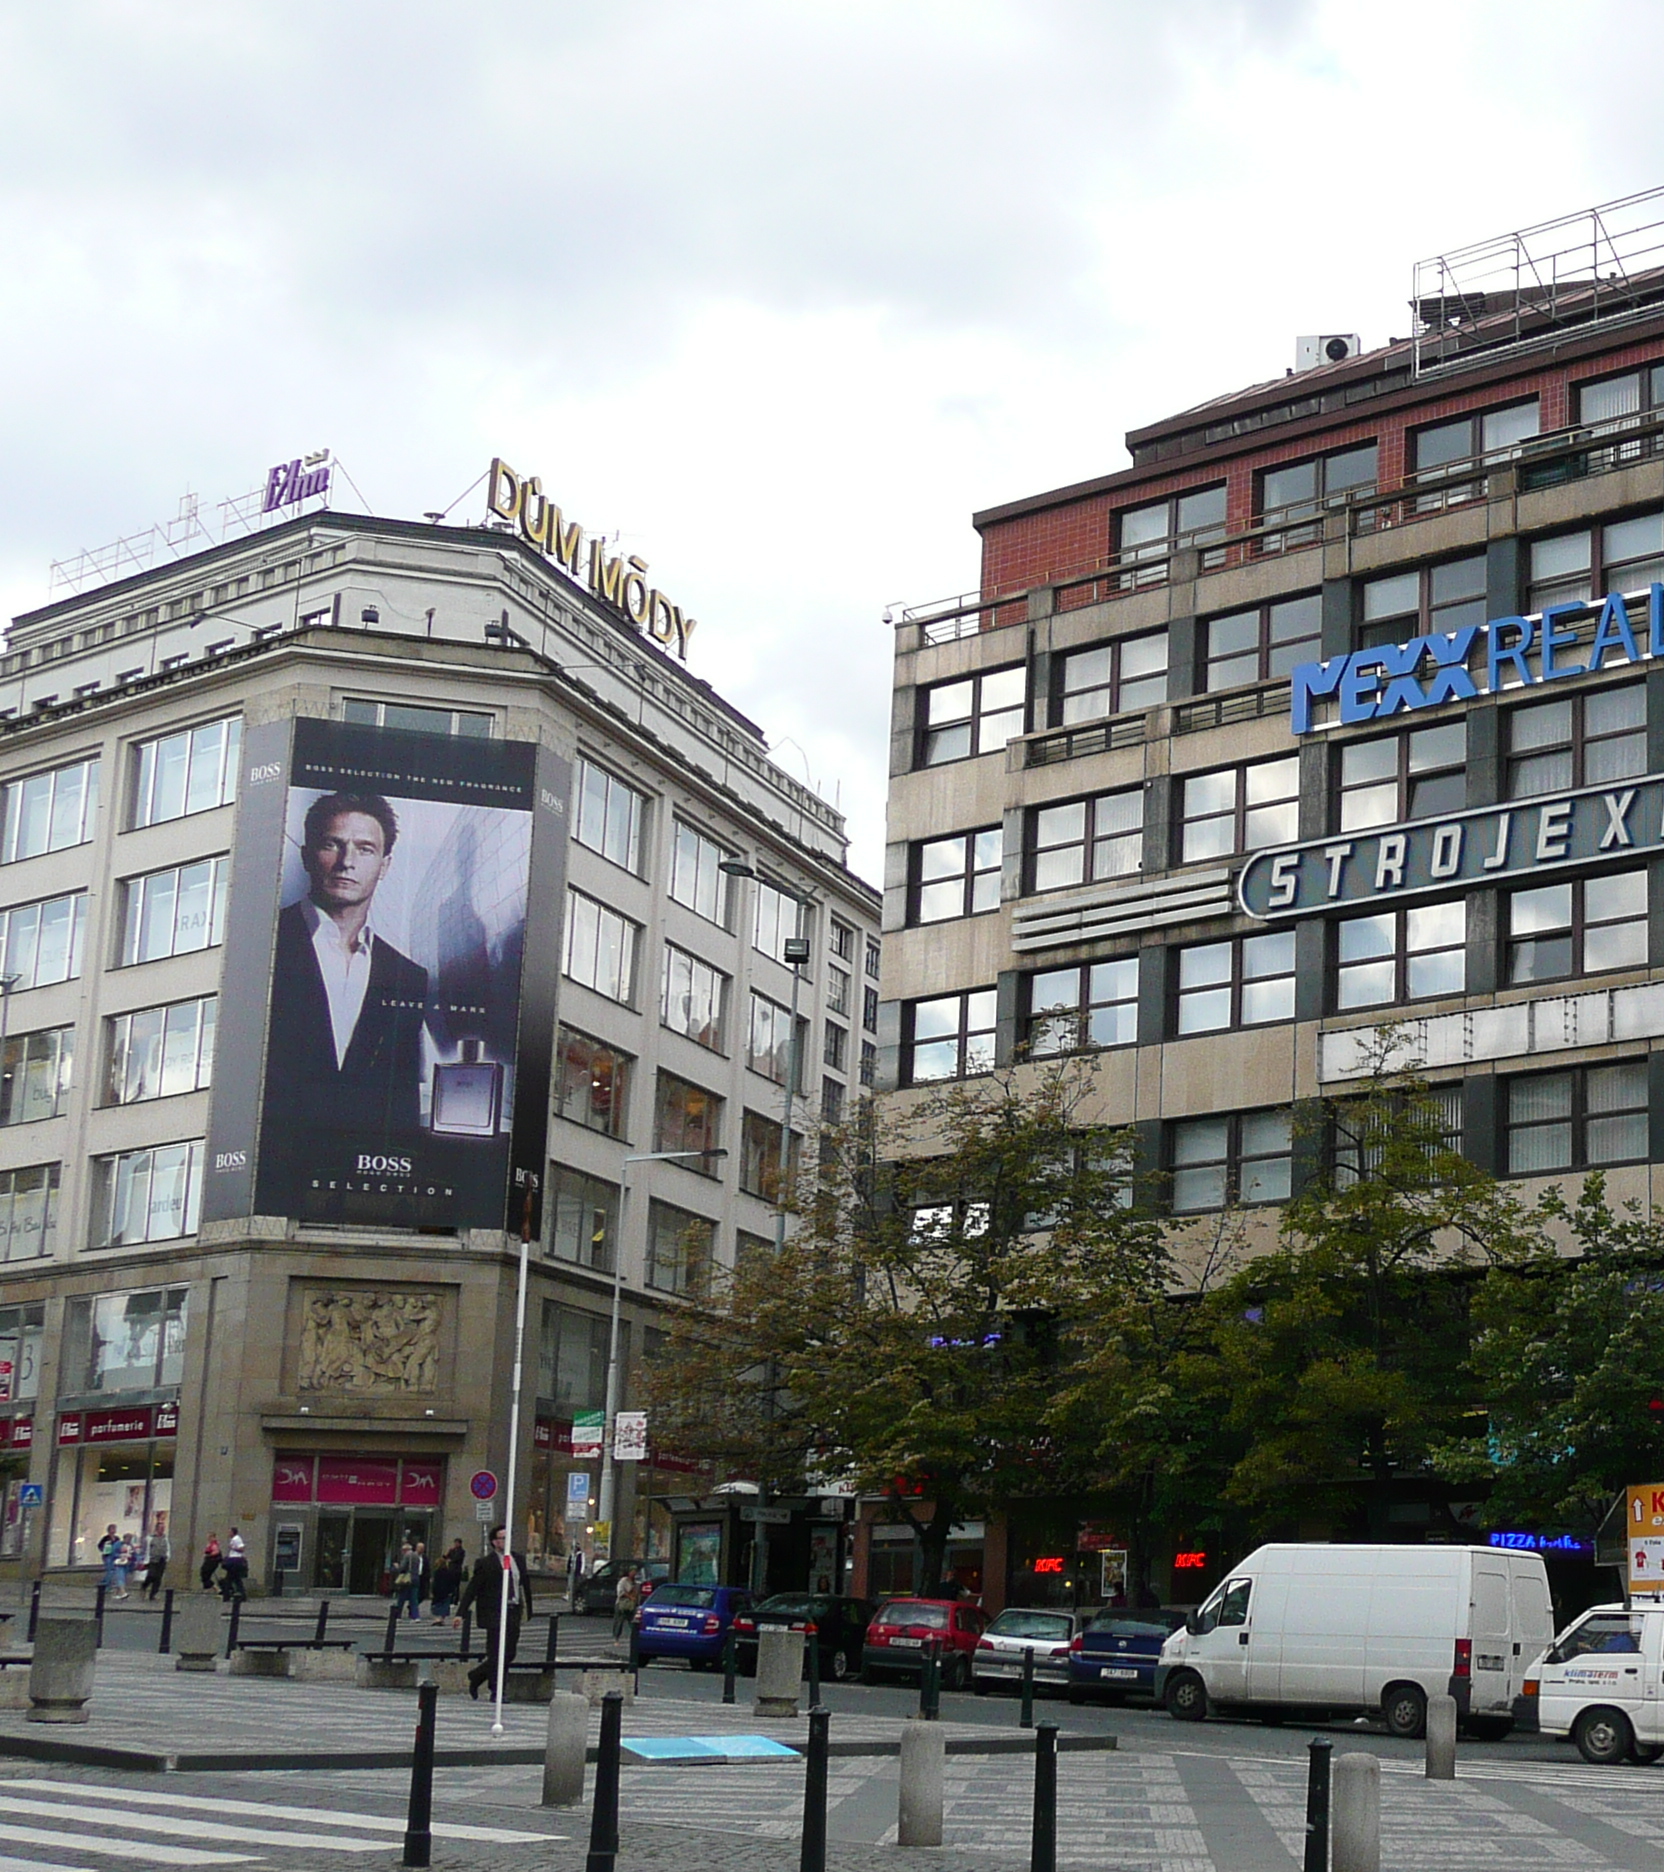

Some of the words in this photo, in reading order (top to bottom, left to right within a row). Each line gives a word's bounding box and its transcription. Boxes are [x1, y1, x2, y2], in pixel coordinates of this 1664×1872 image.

[250, 762, 281, 782] BOSS
[305, 764, 334, 774] BOSS
[339, 767, 401, 780] SELECTION
[406, 775, 426, 784] THE
[432, 777, 454, 786] NEW
[460, 781, 523, 794] FRAGRANCE
[540, 788, 564, 813] BOSS
[382, 999, 424, 1009] LEAVE
[450, 1005, 486, 1014] MARK
[215, 1150, 246, 1169] BOSS
[357, 1154, 412, 1173] BOSS
[312, 1179, 454, 1197] SELECTION
[91, 1419, 144, 1437] parfumerie
[1491, 1533, 1536, 1548] PIZZA
[1034, 1557, 1064, 1573] KFC
[1174, 1552, 1206, 1568] KFC
